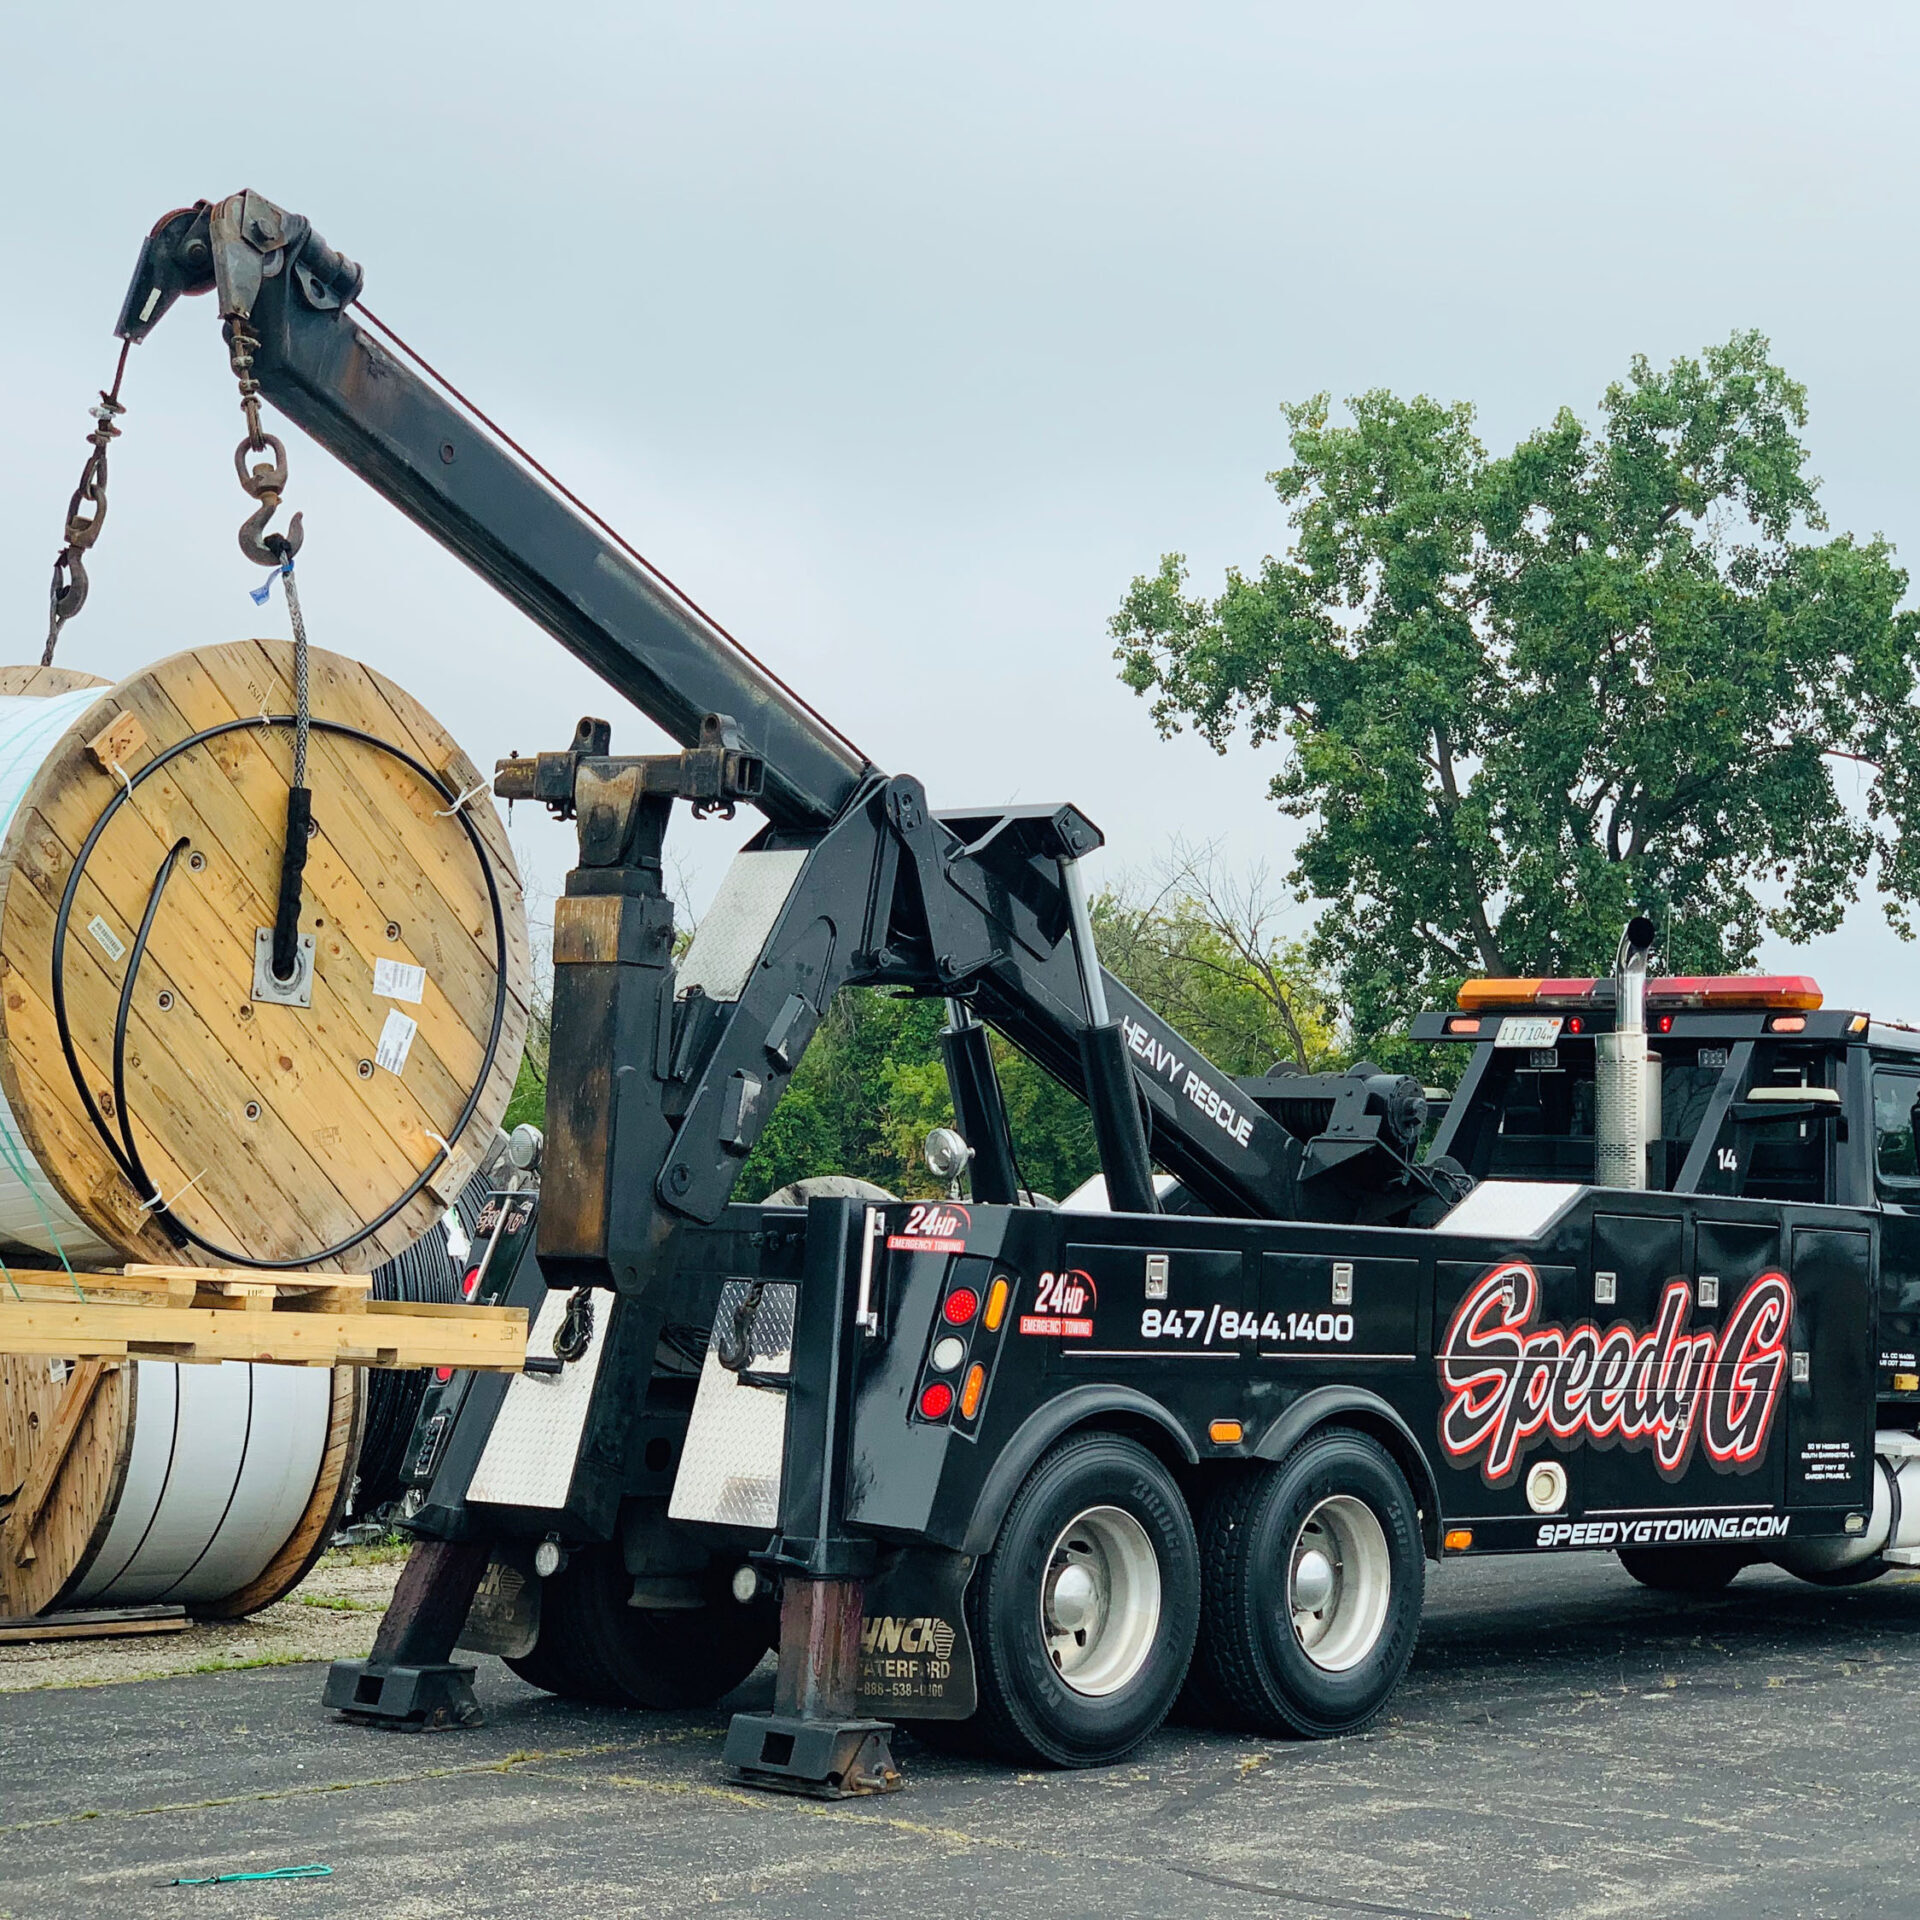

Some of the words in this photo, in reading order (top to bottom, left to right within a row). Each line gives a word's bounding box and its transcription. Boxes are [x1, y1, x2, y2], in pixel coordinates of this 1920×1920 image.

[1122, 1015, 1184, 1083] HEAVY
[1182, 1071, 1253, 1148] RESCUE
[1717, 1148, 1738, 1171] 14
[890, 1238, 933, 1250] EMERGENCY
[934, 1240, 963, 1252] TOWING
[1022, 1319, 1063, 1335] EMERGENCY
[1064, 1320, 1090, 1335] TOWING
[1141, 1304, 1353, 1345] 847/844.1400
[1443, 1259, 1717, 1480] Speedy
[1704, 1272, 1792, 1462] G
[1536, 1515, 1790, 1547] SPEEDYGTOWING.COM
[860, 1616, 939, 1655] YNCH
[861, 1660, 951, 1679] ATERFRD
